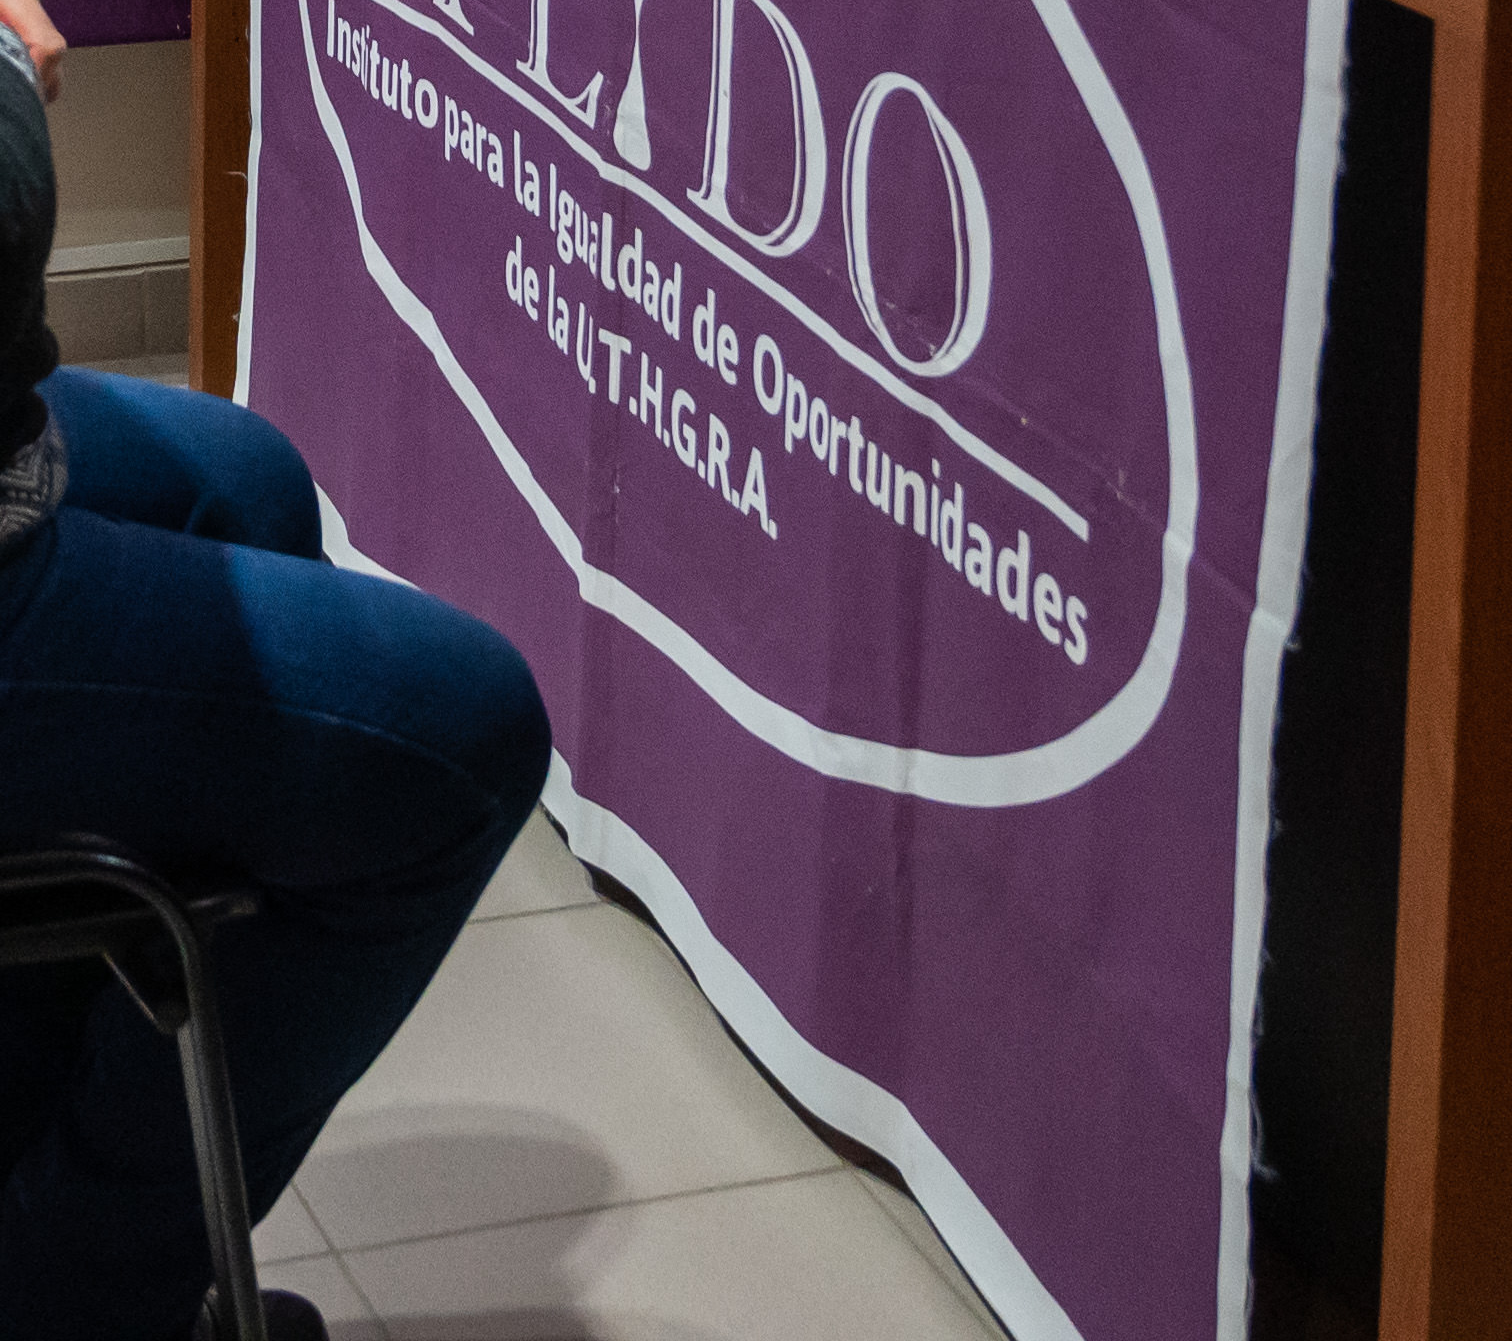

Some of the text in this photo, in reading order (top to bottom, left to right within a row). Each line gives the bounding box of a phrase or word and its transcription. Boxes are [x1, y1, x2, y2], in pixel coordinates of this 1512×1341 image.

[443, 93, 504, 188] para
[513, 129, 541, 217] la
[547, 161, 682, 342] Igualdad
[692, 288, 740, 386] de
[752, 334, 1089, 666] Oportunidades
[503, 235, 778, 541] de la U.T.H.G.R.A.
